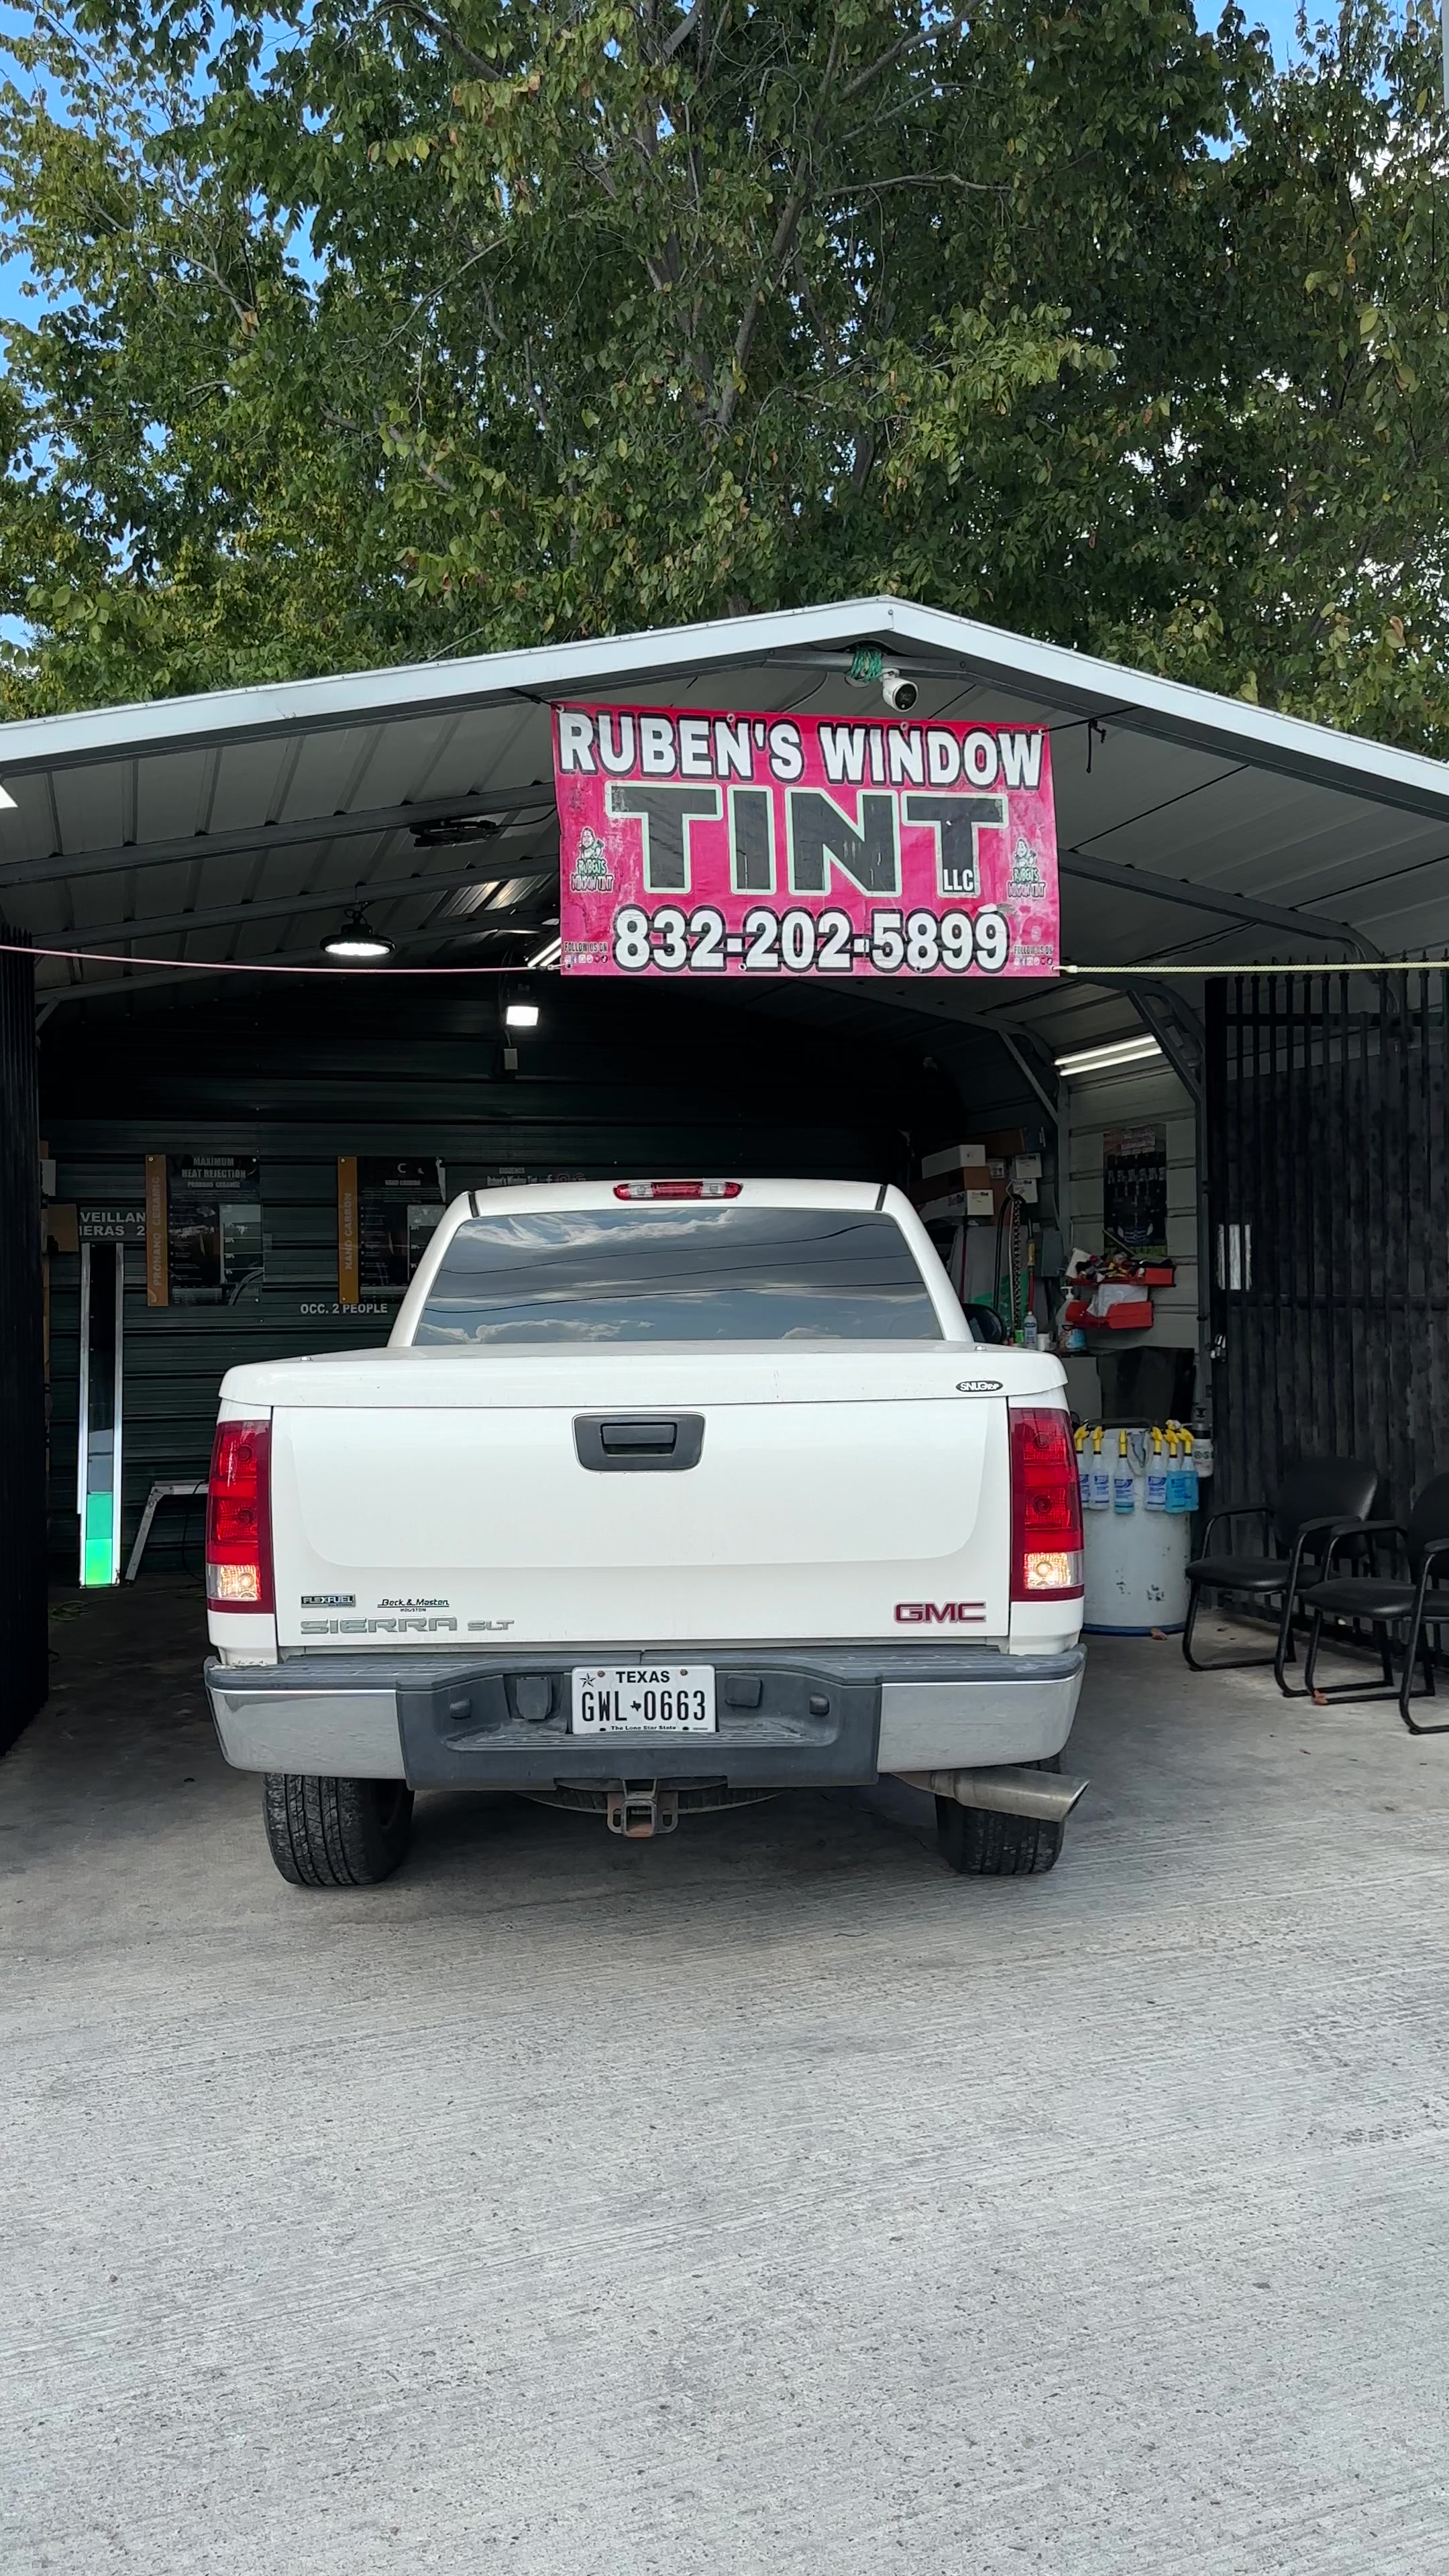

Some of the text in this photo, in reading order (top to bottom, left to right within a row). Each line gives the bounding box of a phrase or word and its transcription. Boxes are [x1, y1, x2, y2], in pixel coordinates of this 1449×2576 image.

[558, 710, 1043, 789] RUBEN'S WINDOW
[604, 782, 1009, 898] TINT
[943, 869, 974, 892] LLC
[565, 942, 607, 952] FOLLOW US ON
[614, 906, 1010, 972] 832-202-5899
[193, 1157, 234, 1167] MAXIMUM
[182, 1169, 246, 1179] HEAT REJECTION
[152, 1176, 162, 1287] PRONANO CERAMIC
[343, 1192, 353, 1271] NANO CARBON
[300, 1303, 388, 1314] OCC. 2 PEOPLE
[894, 1601, 987, 1623] GMC
[301, 1615, 515, 1634] SIERRA SLT
[616, 1670, 670, 1683] TEXAS
[582, 1690, 705, 1721] GWL 0663
